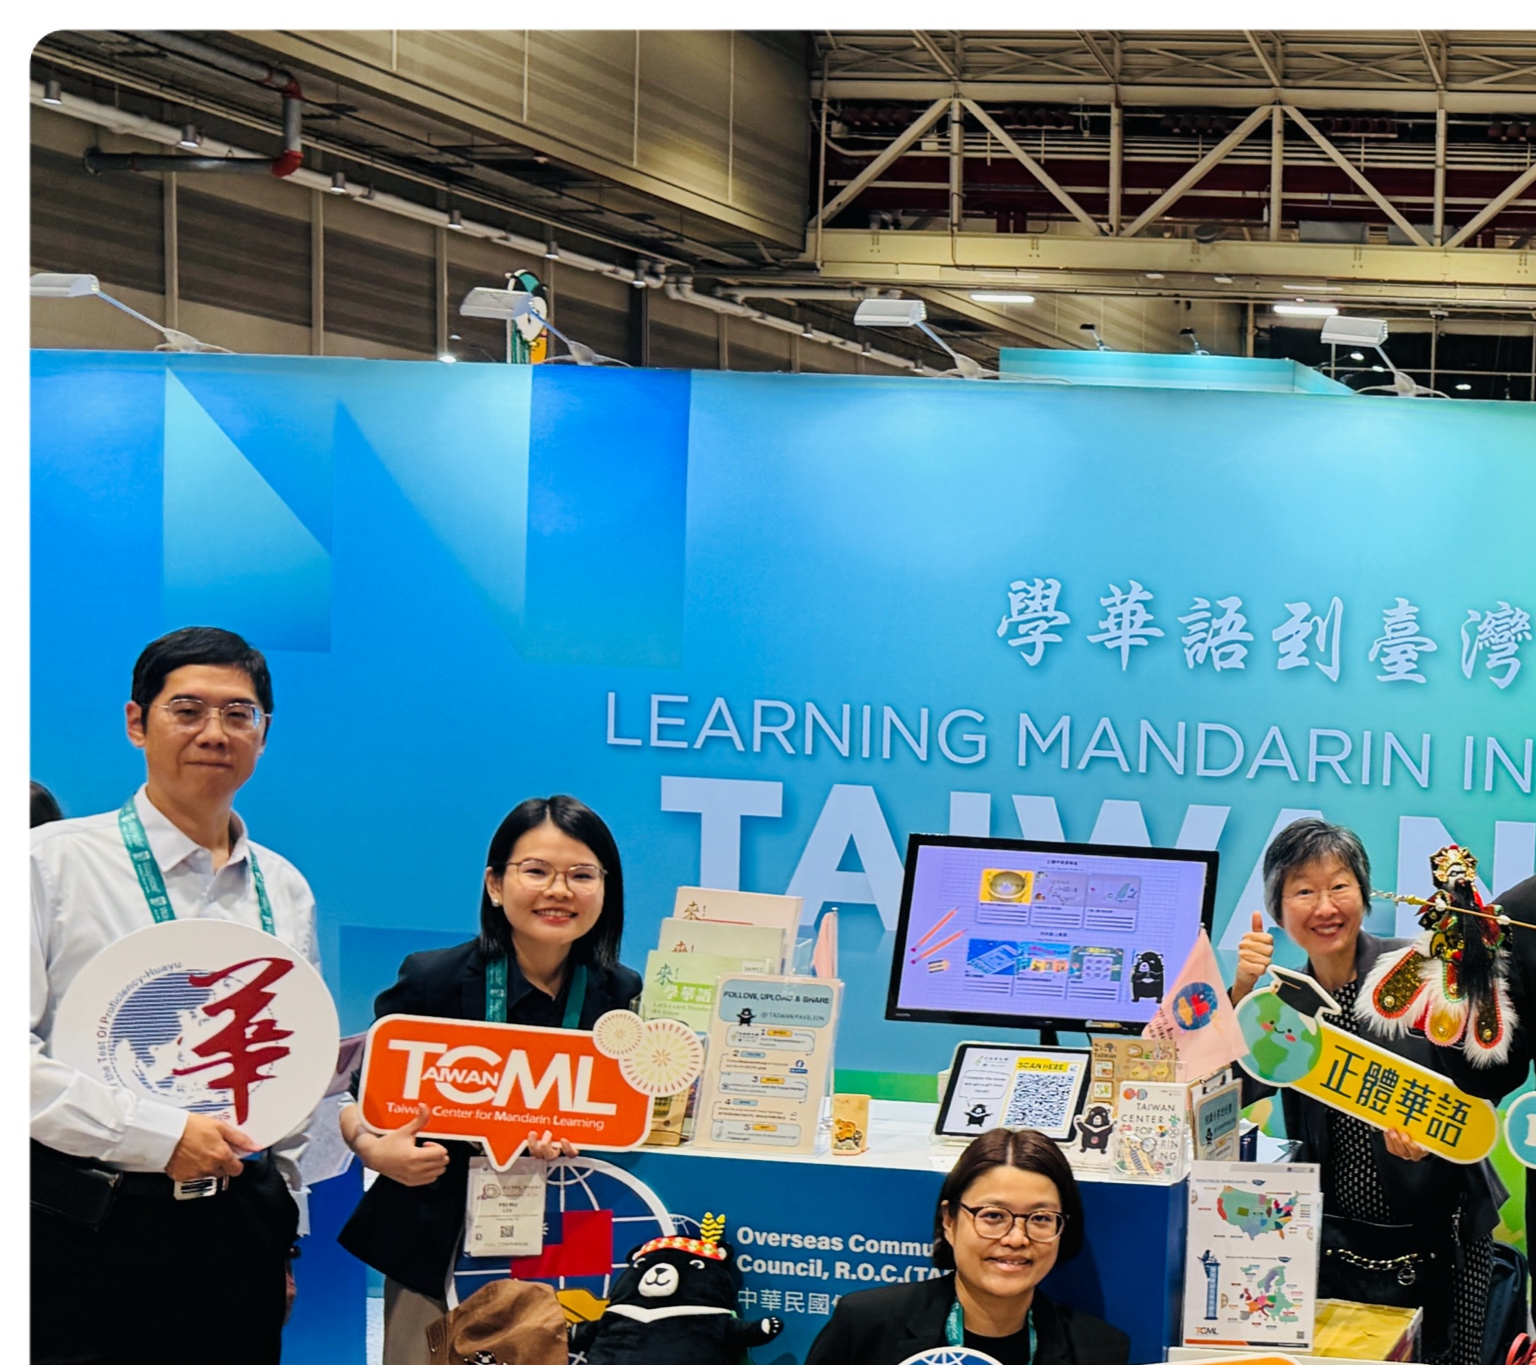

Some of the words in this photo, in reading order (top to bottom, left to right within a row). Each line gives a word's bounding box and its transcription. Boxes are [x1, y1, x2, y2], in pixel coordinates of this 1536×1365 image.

[997, 577, 1533, 689] 學華語到臺灣
[606, 692, 987, 764] LEARNING
[1017, 713, 1431, 789] MANDARIN
[1463, 735, 1534, 793] IN
[97, 1023, 108, 1039] Of
[172, 957, 294, 1126] 華
[97, 1040, 108, 1064] Test
[1137, 1103, 1175, 1112] TAIWAN
[1320, 1044, 1472, 1148] 正體華語
[386, 1102, 426, 1115] Taiwa
[432, 1106, 473, 1119] Center
[475, 1109, 492, 1120] for
[494, 1111, 551, 1126] Mandarin
[553, 1116, 605, 1131] Learning
[1121, 1114, 1164, 1124] CENTER
[737, 1226, 844, 1252] Overseas
[849, 1234, 934, 1258] Commu
[737, 1254, 829, 1281] Council,
[834, 1261, 955, 1284] R.O.C.(TA
[737, 1287, 839, 1316] 中華民國
[1195, 1327, 1219, 1336] TCML
